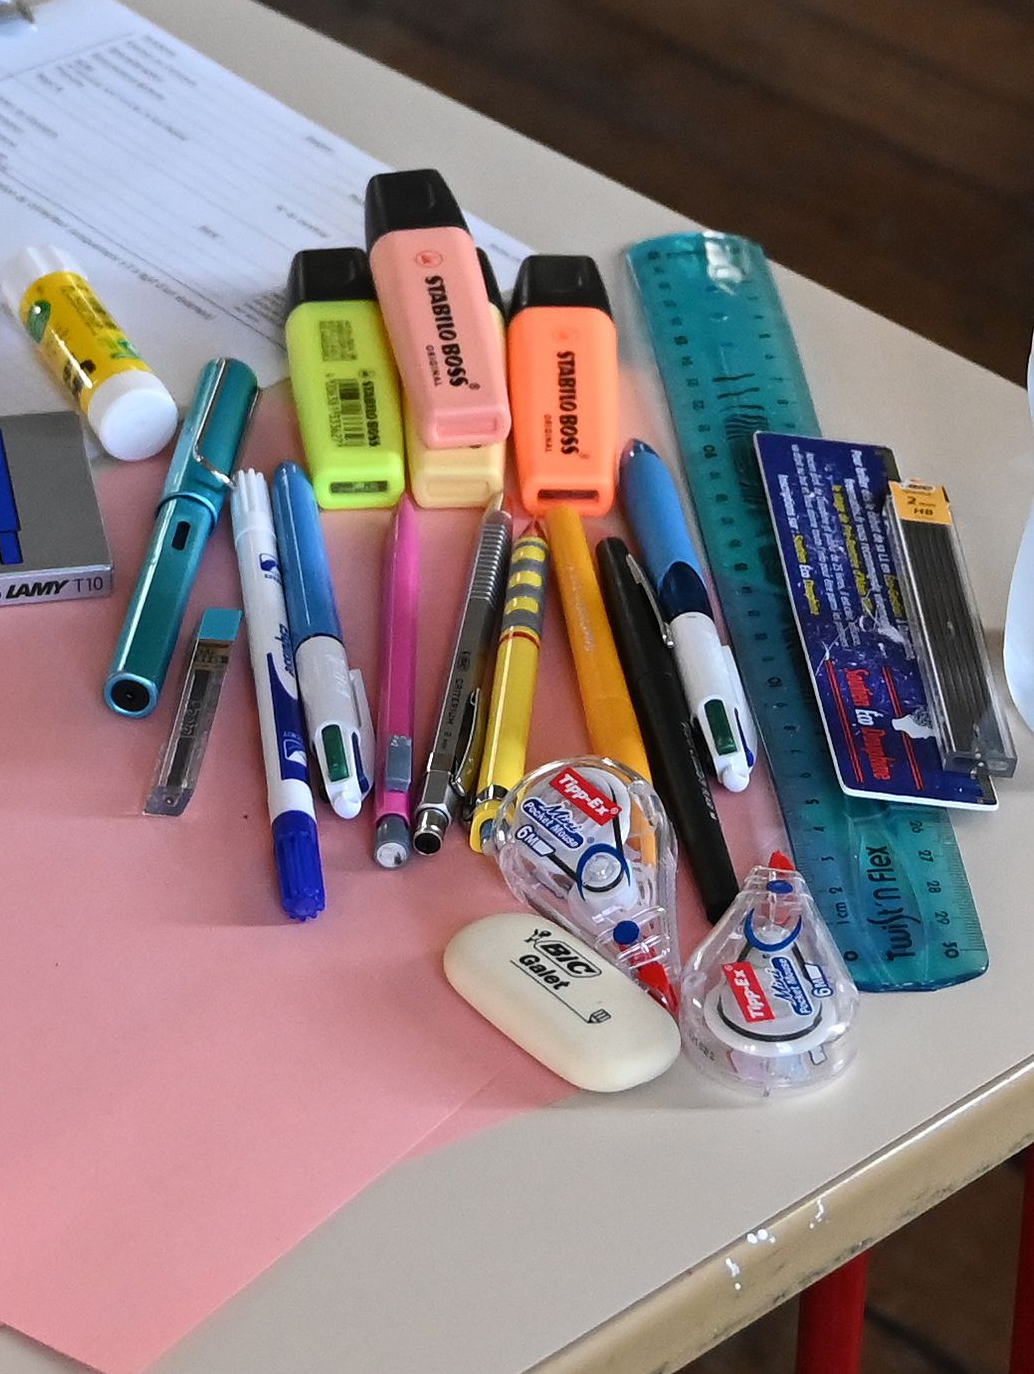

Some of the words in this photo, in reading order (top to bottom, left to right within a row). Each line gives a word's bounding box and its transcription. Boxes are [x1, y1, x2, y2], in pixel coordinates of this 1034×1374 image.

[425, 276, 457, 341] STABILO
[441, 343, 468, 387] BOSS
[425, 345, 442, 386] ORIGINAL
[557, 351, 577, 411] STABILO
[559, 414, 579, 455] BOSS
[5, 579, 69, 599] LAMY
[855, 708, 882, 725] Éco
[559, 773, 609, 816] Tipp-Ex
[524, 801, 553, 827] Pocket
[551, 825, 578, 848] Mouse
[866, 846, 897, 884] Flex
[918, 849, 934, 863] 27
[829, 886, 843, 894] 2
[926, 881, 942, 894] 28
[935, 911, 950, 925] 29
[540, 944, 596, 974] BIC
[844, 950, 858, 961] 0
[943, 942, 959, 959] 30
[519, 955, 570, 990] Galet
[733, 969, 764, 1018] Tipp-Ex
